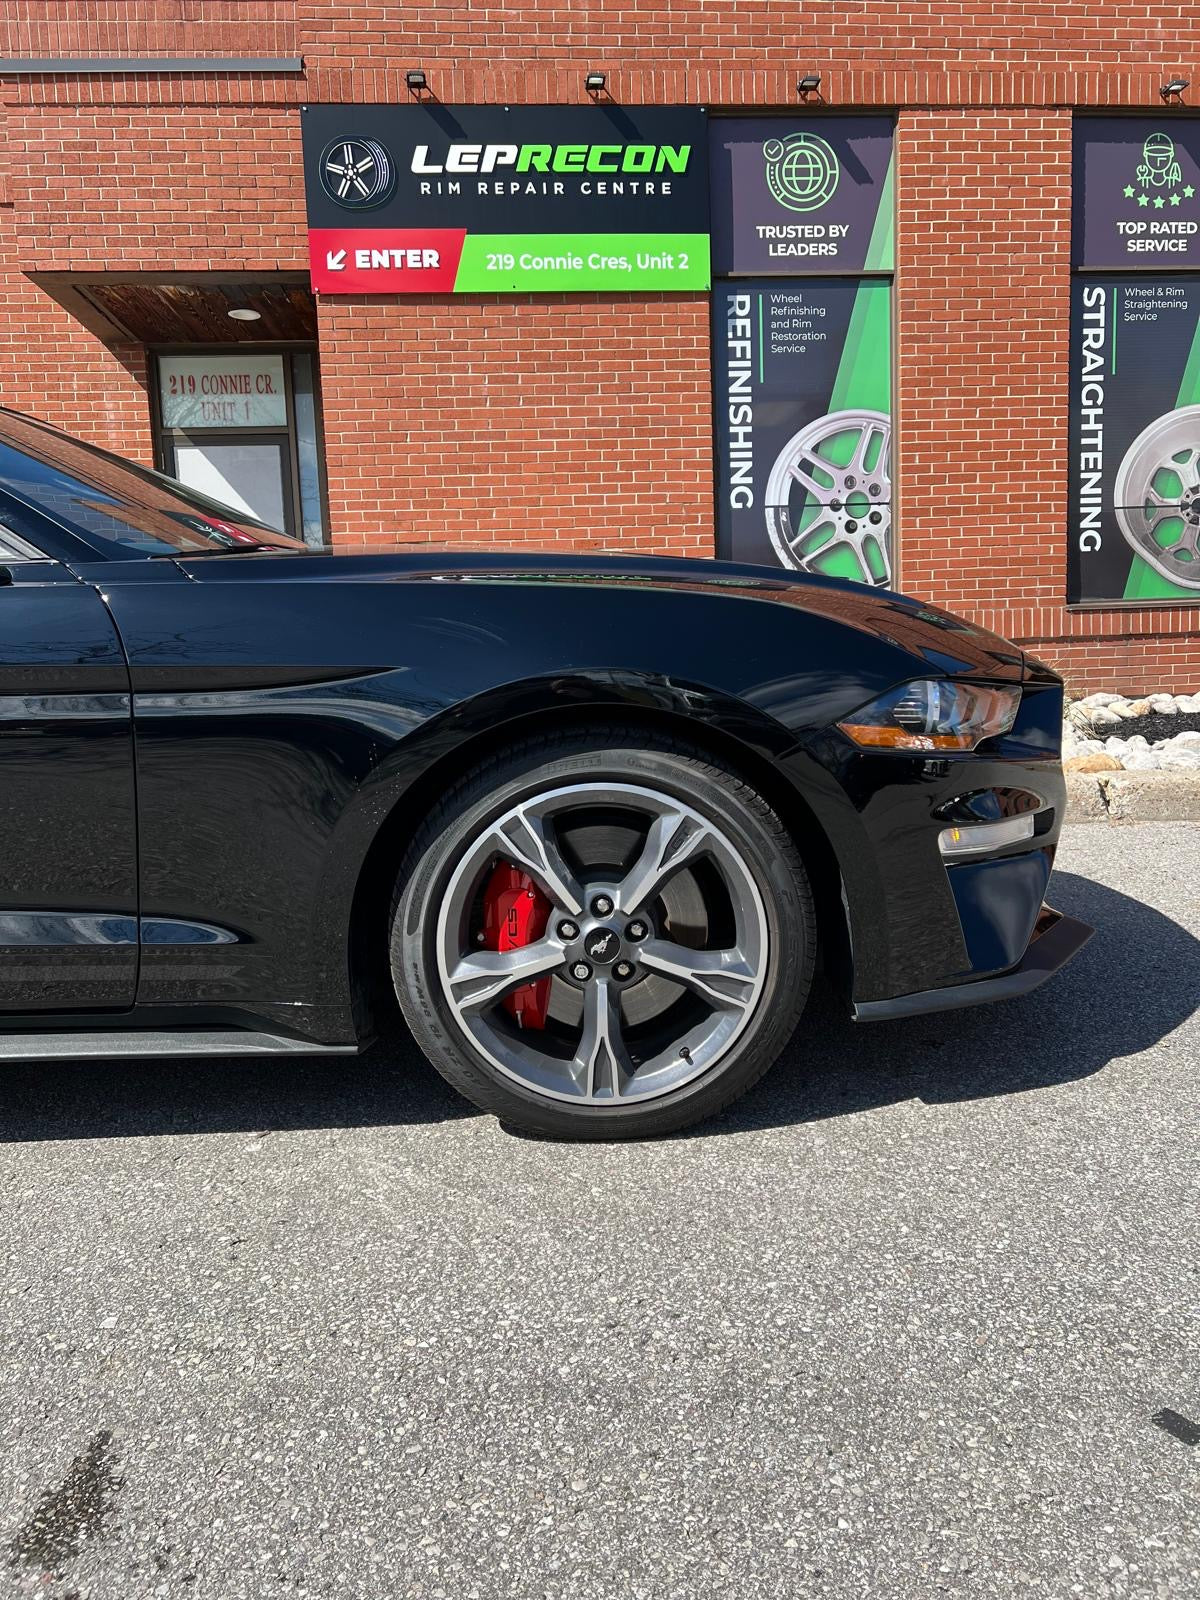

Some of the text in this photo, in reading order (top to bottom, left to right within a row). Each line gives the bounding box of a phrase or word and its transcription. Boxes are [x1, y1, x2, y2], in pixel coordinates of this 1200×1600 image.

[410, 143, 692, 175] LEPRECON
[420, 181, 673, 196] RIM REPAIR CENTRE
[756, 224, 850, 239] TRUSTED BY
[1116, 221, 1198, 235] TOP RATED
[769, 243, 838, 257] LEADERS
[1127, 239, 1188, 252] SERVICE
[354, 248, 440, 269] ENTER
[485, 252, 690, 273] 219 Connie Cres, Unit 2
[770, 294, 802, 303] Wheel
[1124, 286, 1185, 297] Wheel & Rim
[770, 306, 826, 317] Refinishing
[1124, 299, 1188, 310] Straightening
[770, 319, 812, 329] and Rim
[1123, 312, 1158, 322] Service
[771, 331, 827, 341] Restoration
[771, 344, 806, 354] Service
[169, 374, 278, 395] 219 CONNIE CR.
[727, 294, 754, 509] REFINISHING
[201, 400, 251, 422] UNIT 1
[1079, 286, 1106, 552] STRAIGHTENING
